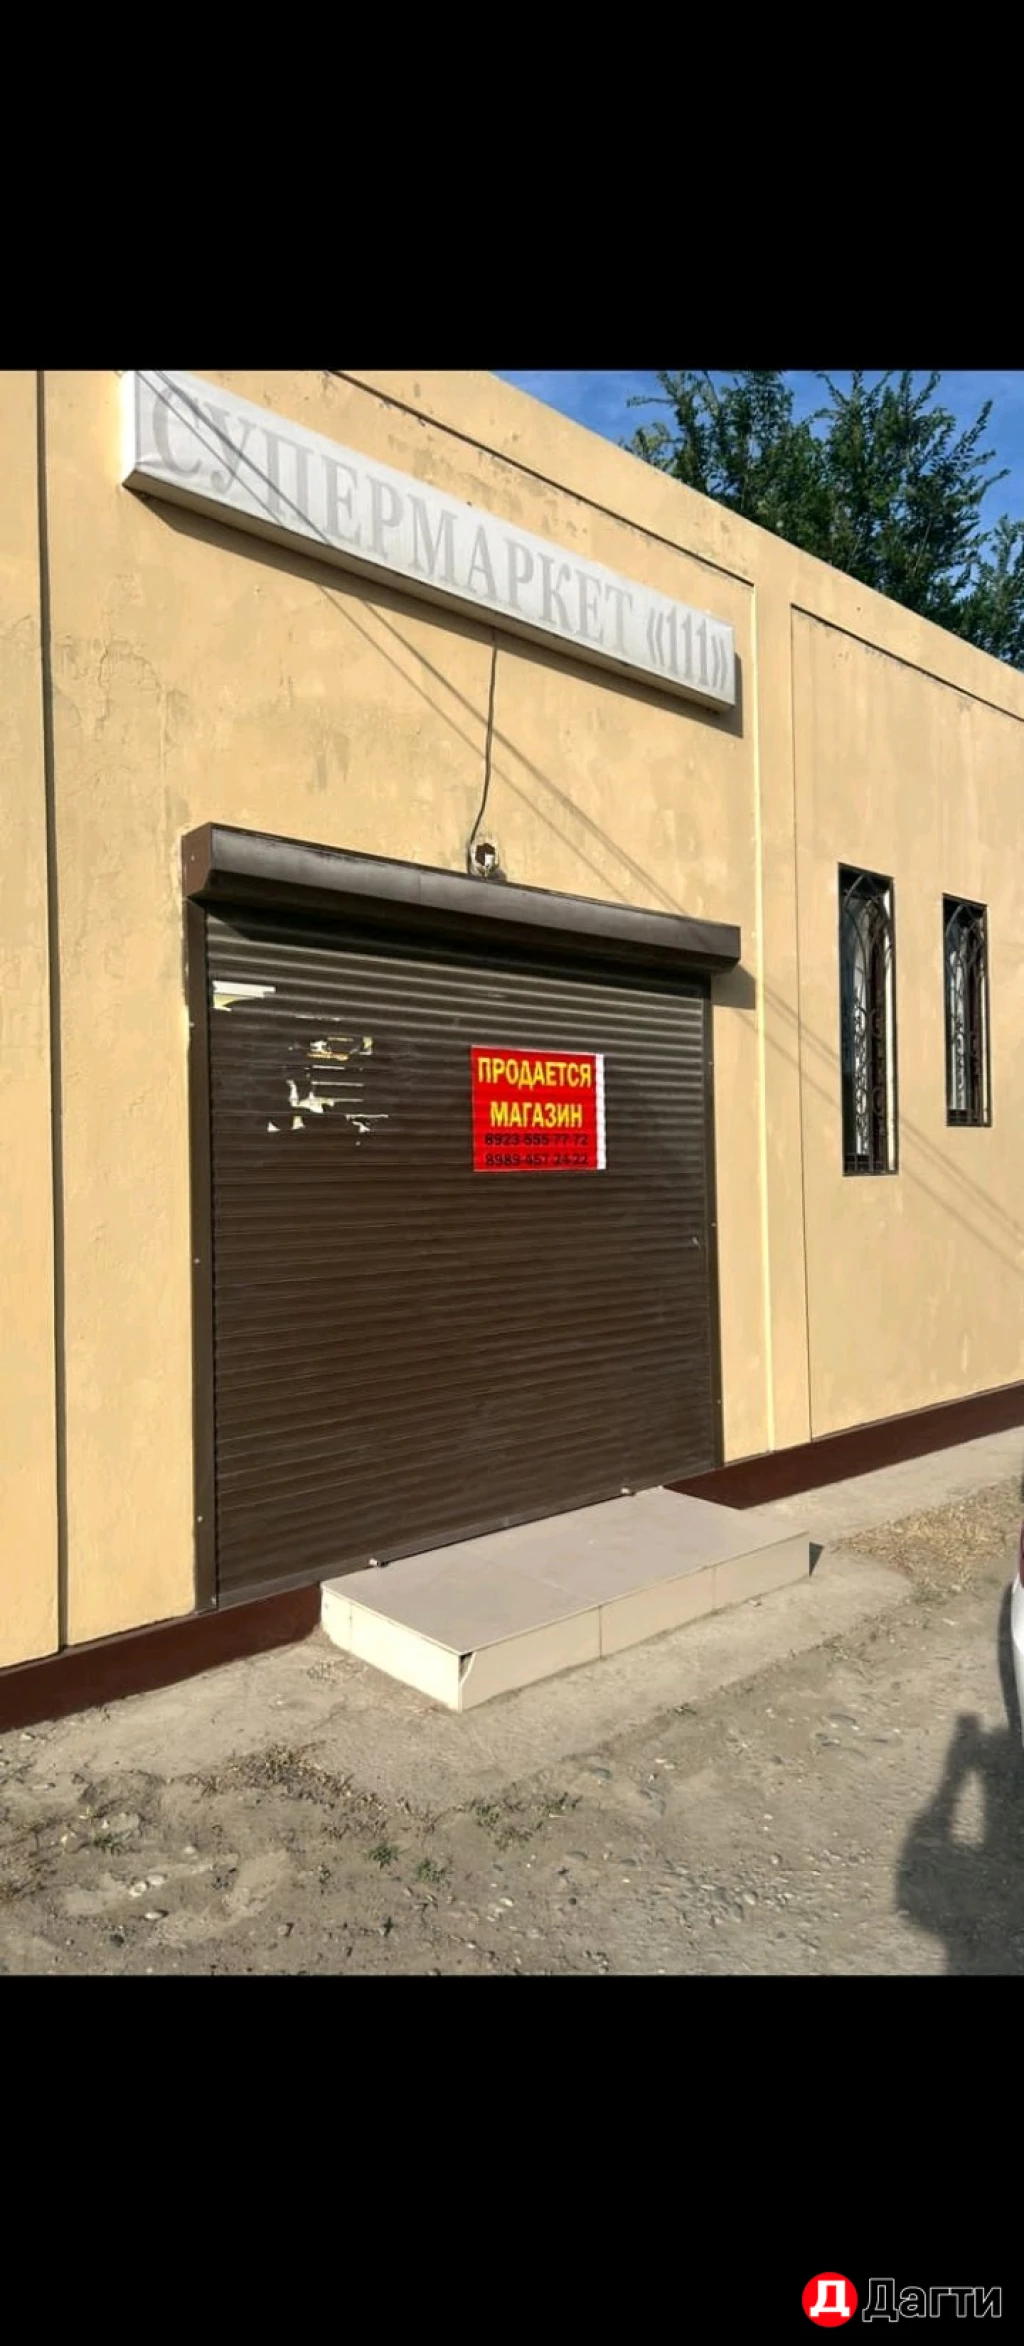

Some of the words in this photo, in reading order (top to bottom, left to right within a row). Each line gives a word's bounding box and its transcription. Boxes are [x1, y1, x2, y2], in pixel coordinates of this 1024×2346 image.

[152, 385, 634, 653] СУПЕРМАРКЕТ
[477, 1056, 592, 1091] ПРОДАЕТСЯ
[490, 1101, 583, 1129] МАГАЗИН
